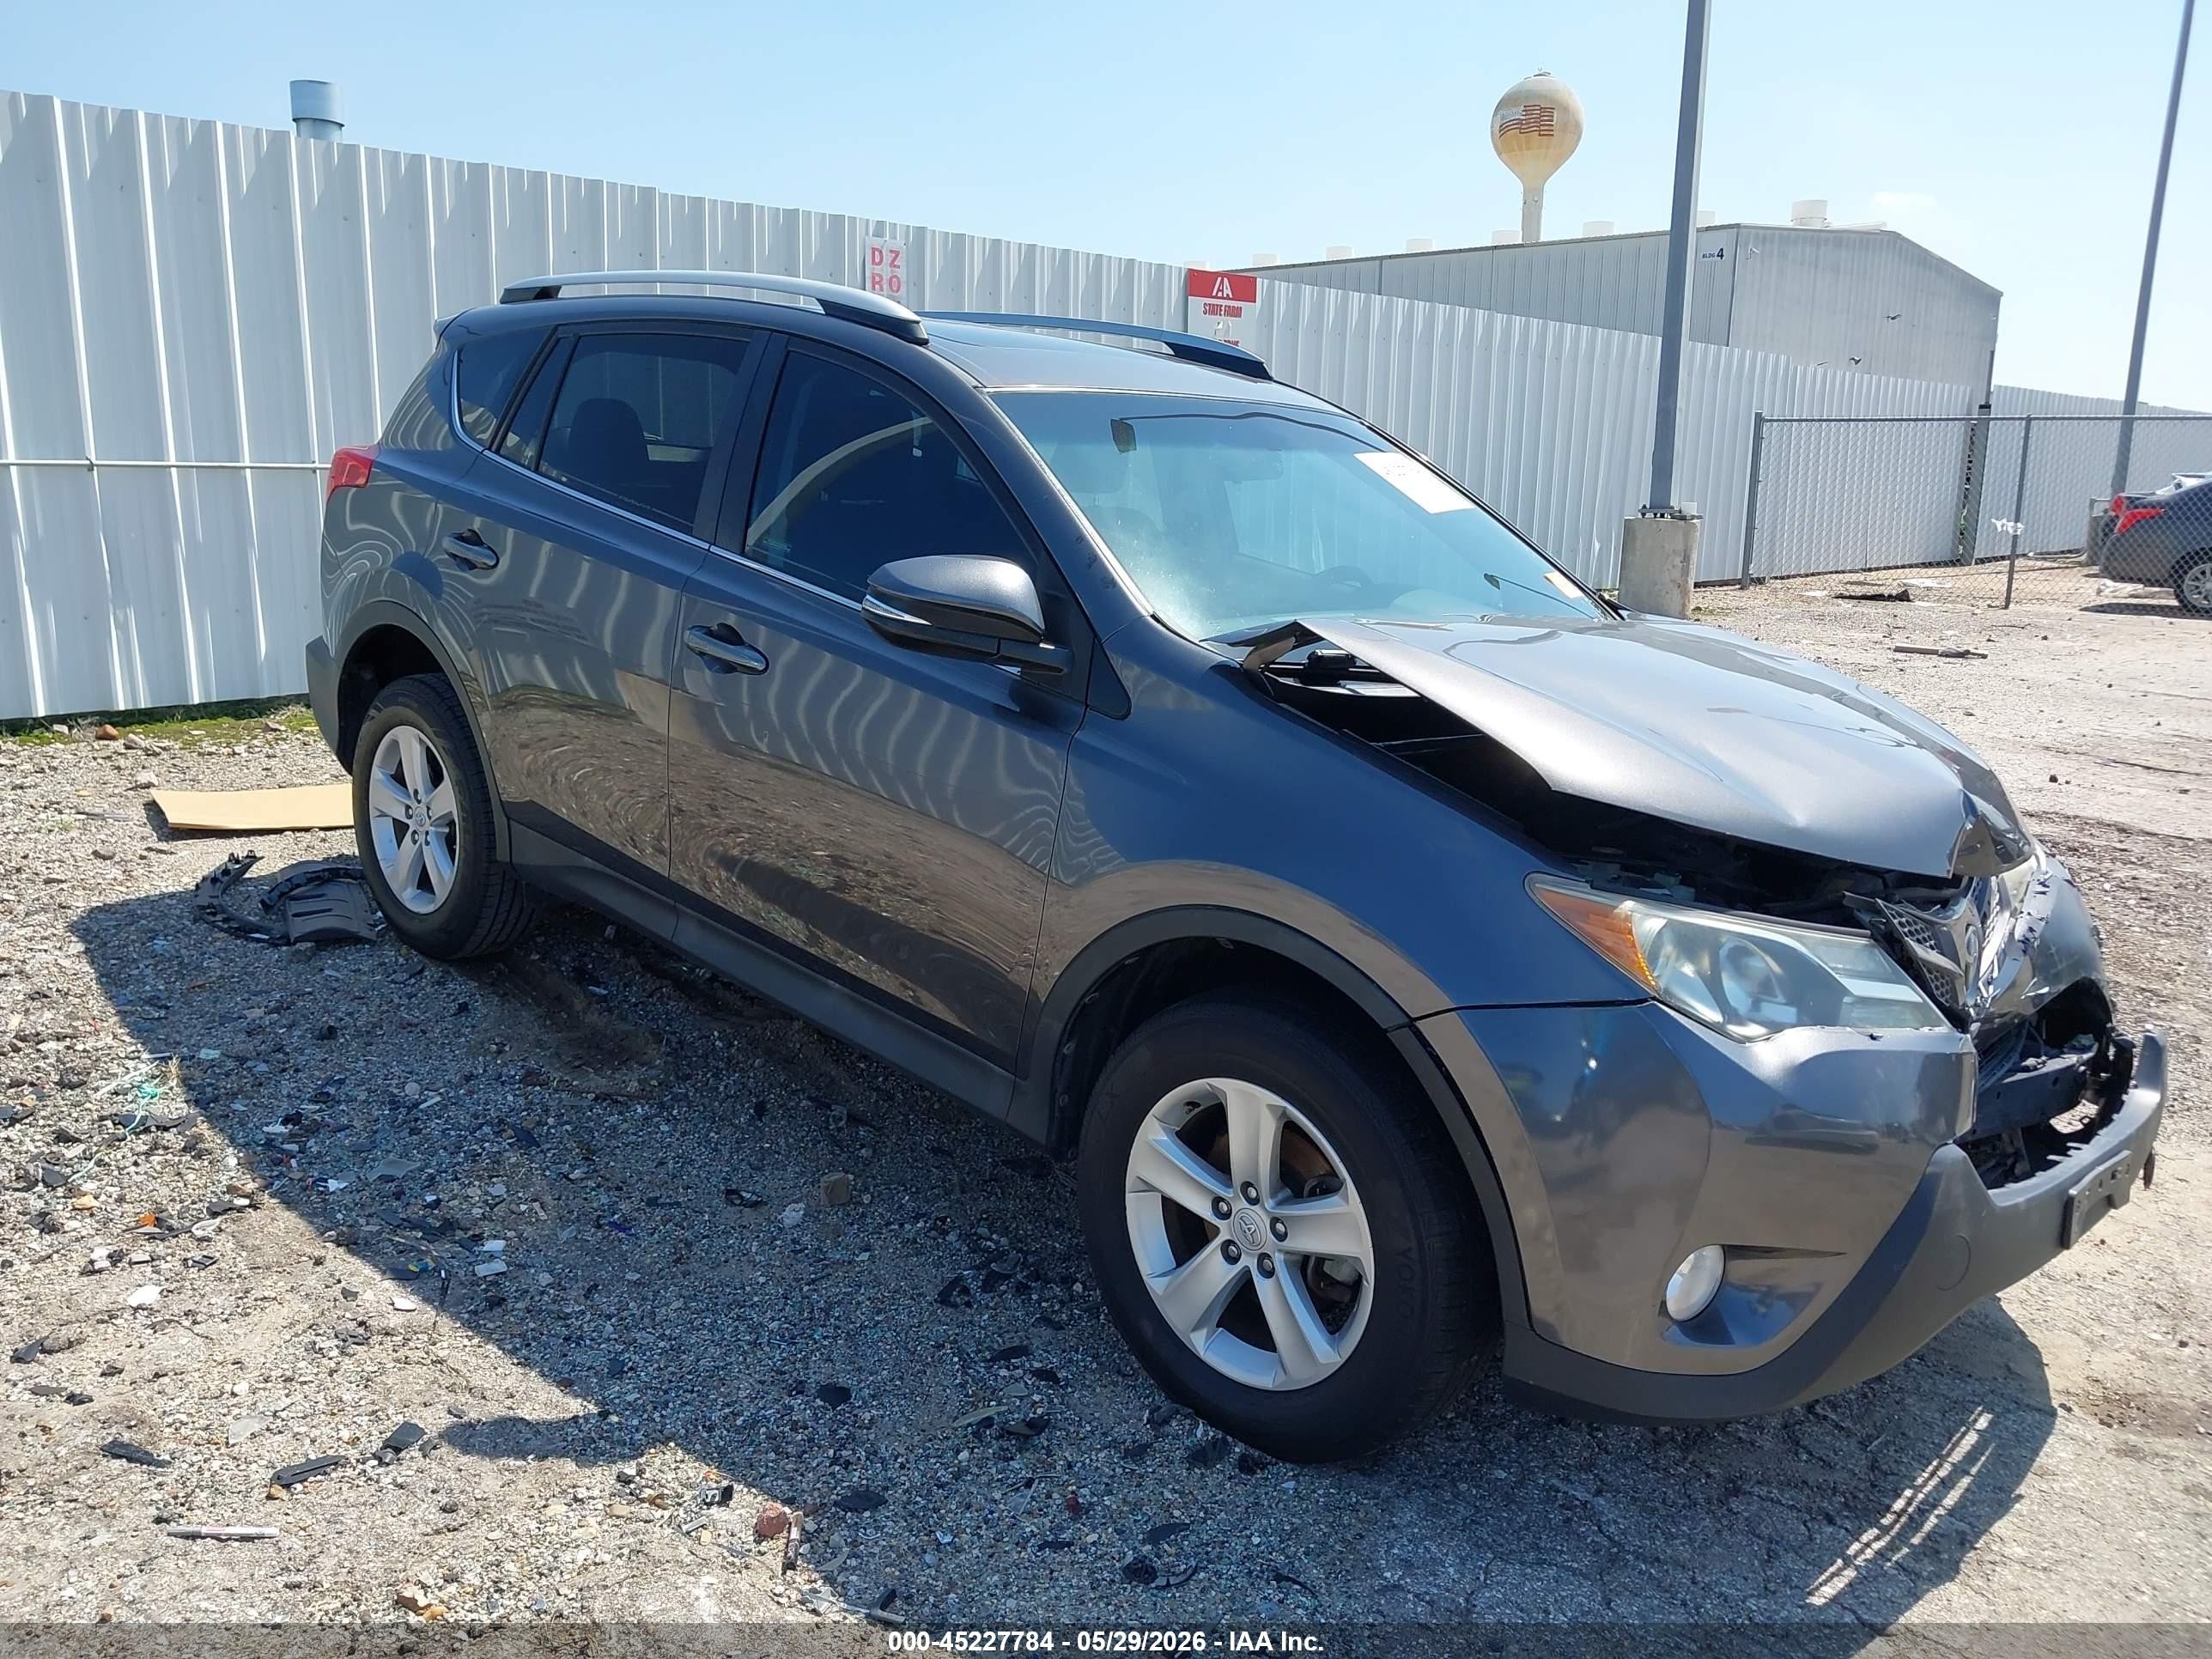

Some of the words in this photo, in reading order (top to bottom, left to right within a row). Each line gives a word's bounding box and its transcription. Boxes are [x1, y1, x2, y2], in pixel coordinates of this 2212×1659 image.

[1717, 247, 1724, 260] 4
[1202, 302, 1224, 317] STATE
[1224, 305, 1243, 319] FARM
